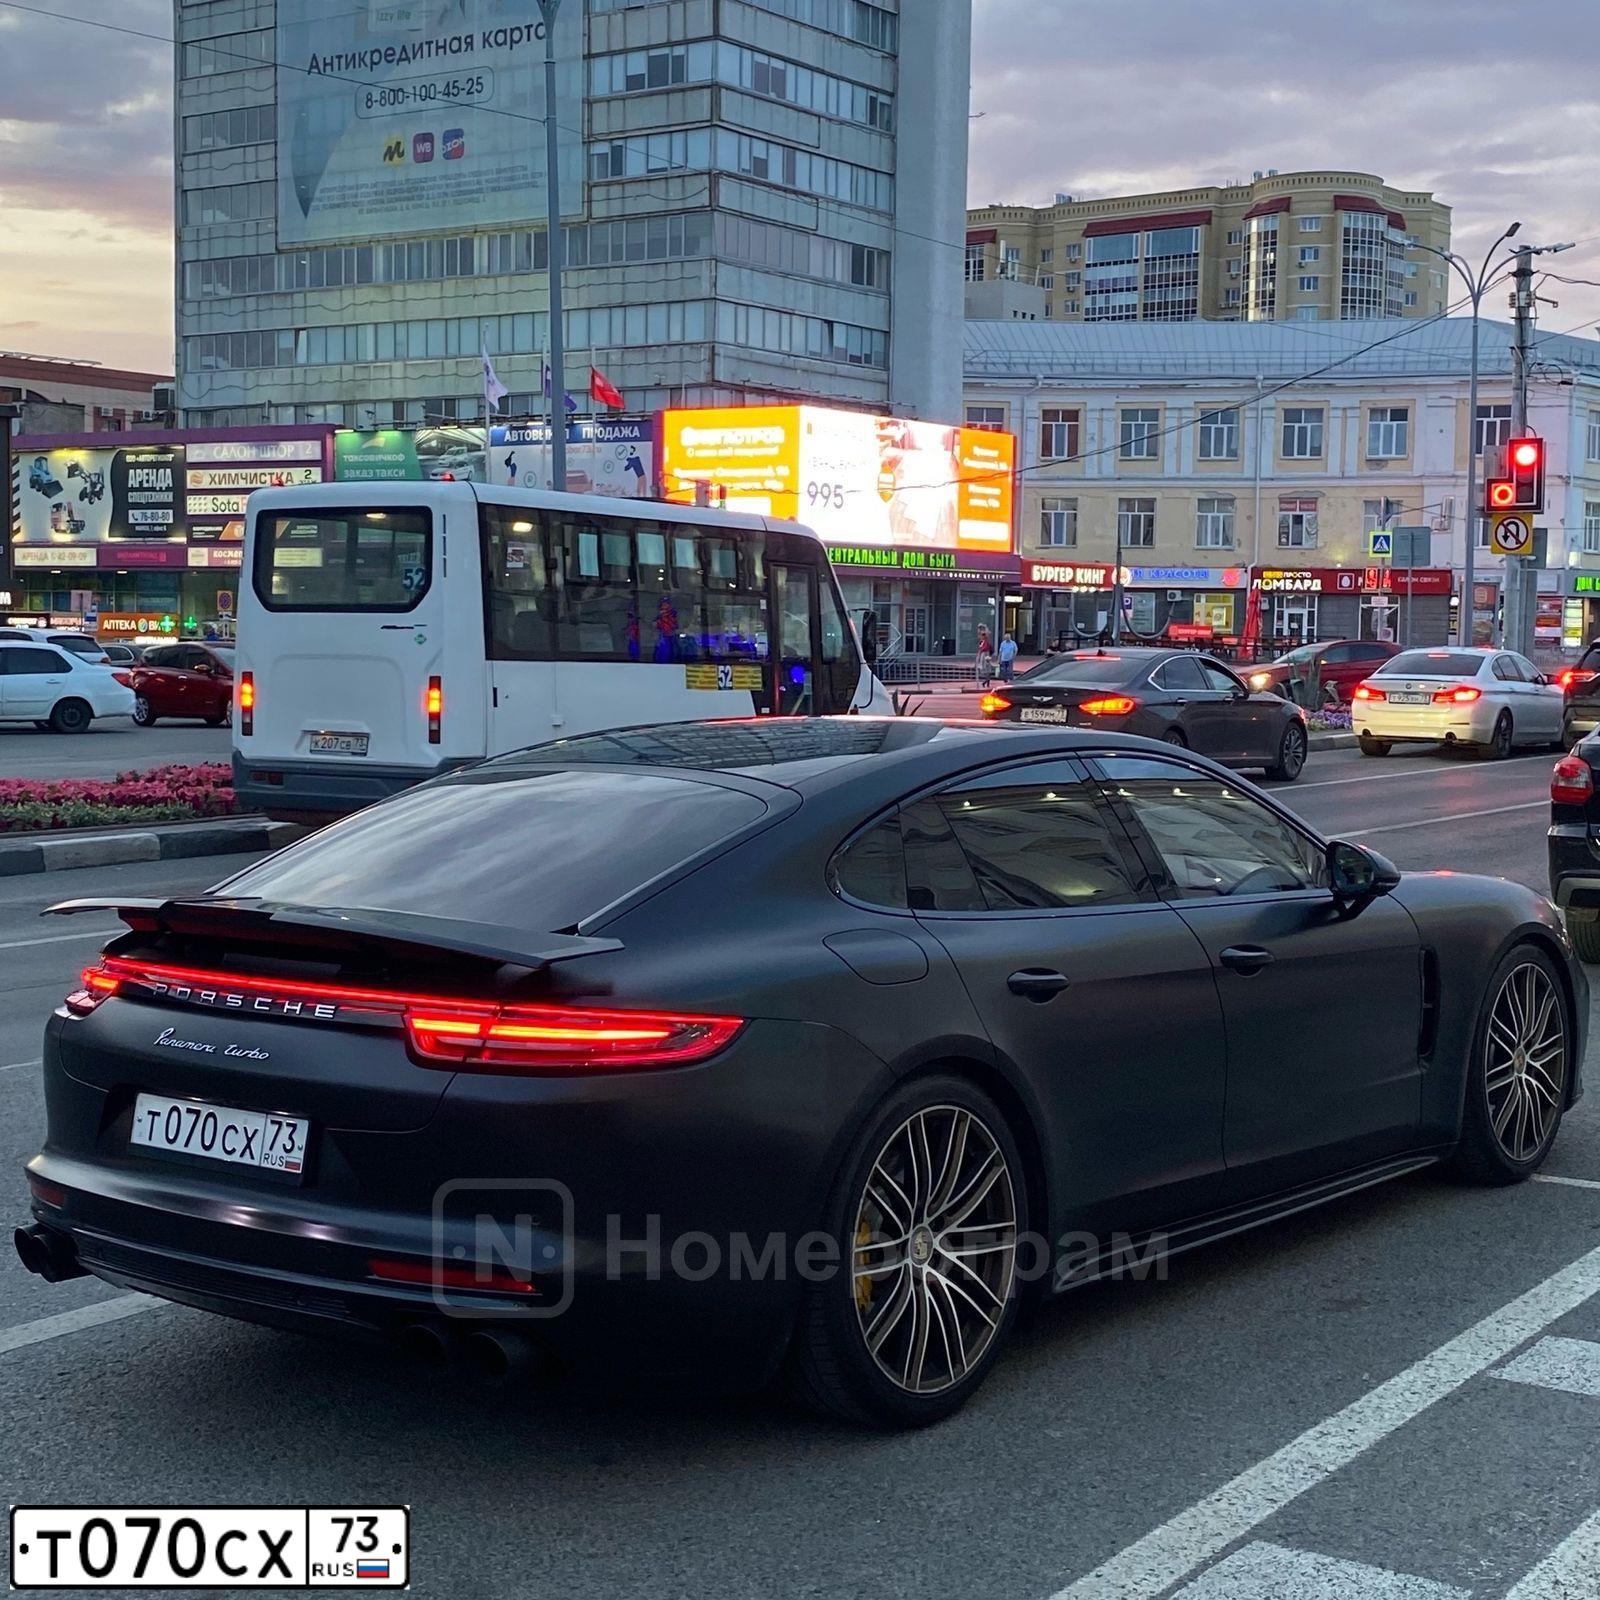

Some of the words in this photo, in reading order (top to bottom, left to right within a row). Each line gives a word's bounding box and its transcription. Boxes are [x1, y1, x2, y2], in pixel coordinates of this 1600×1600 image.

[307, 33, 474, 76] Антикредитная
[482, 21, 546, 49] карта
[365, 76, 484, 109] 8-800-100-45-25
[416, 142, 432, 153] WB
[582, 426, 640, 440] ПРОДАЖА
[213, 445, 256, 459] САЛОН
[260, 444, 295, 458] ШТОР
[305, 443, 312, 455] 2
[128, 468, 173, 490] АРЕНДА
[208, 472, 294, 486] ХИМЧИСТКА
[304, 469, 312, 480] 2
[375, 468, 405, 477] такси
[807, 481, 844, 509] 995
[829, 548, 897, 566] ЕНТРАЛЬНЫЙ
[902, 551, 924, 568] ДОМ
[929, 553, 955, 568] БЫТА
[403, 568, 425, 591] 52
[1032, 565, 1074, 583] БУРГЕР
[1076, 567, 1106, 584] КИНГ
[1150, 568, 1209, 578] КРАСОТЫ
[1252, 579, 1322, 591] ЛОМБАРД
[102, 620, 137, 631] АПТЕКА
[718, 665, 733, 688] 52
[153, 982, 336, 1019] PORSCHE
[153, 1027, 216, 1053] Panamera
[224, 1043, 269, 1060] turbo
[268, 1118, 298, 1155] 73
[262, 1152, 285, 1168] RUS
